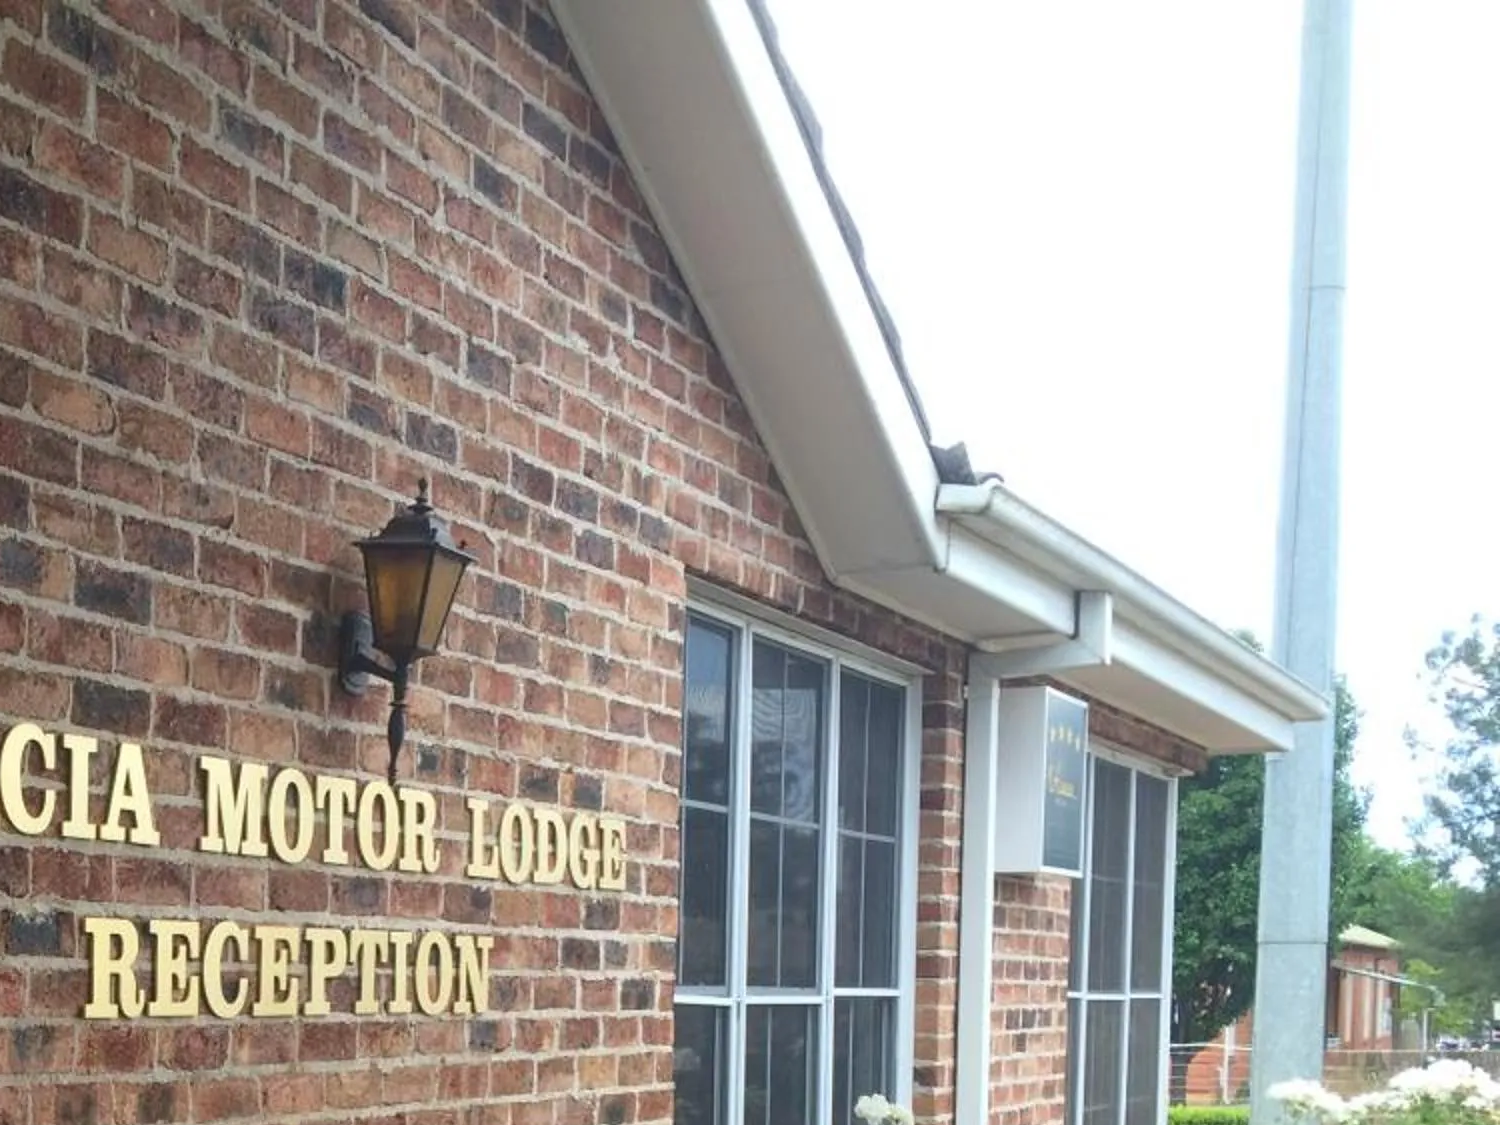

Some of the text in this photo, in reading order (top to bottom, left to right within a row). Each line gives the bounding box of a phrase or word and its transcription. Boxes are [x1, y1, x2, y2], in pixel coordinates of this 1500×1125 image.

[199, 756, 442, 875] MOTOR
[466, 796, 628, 891] LODGE
[83, 917, 495, 1020] RECEPTION
